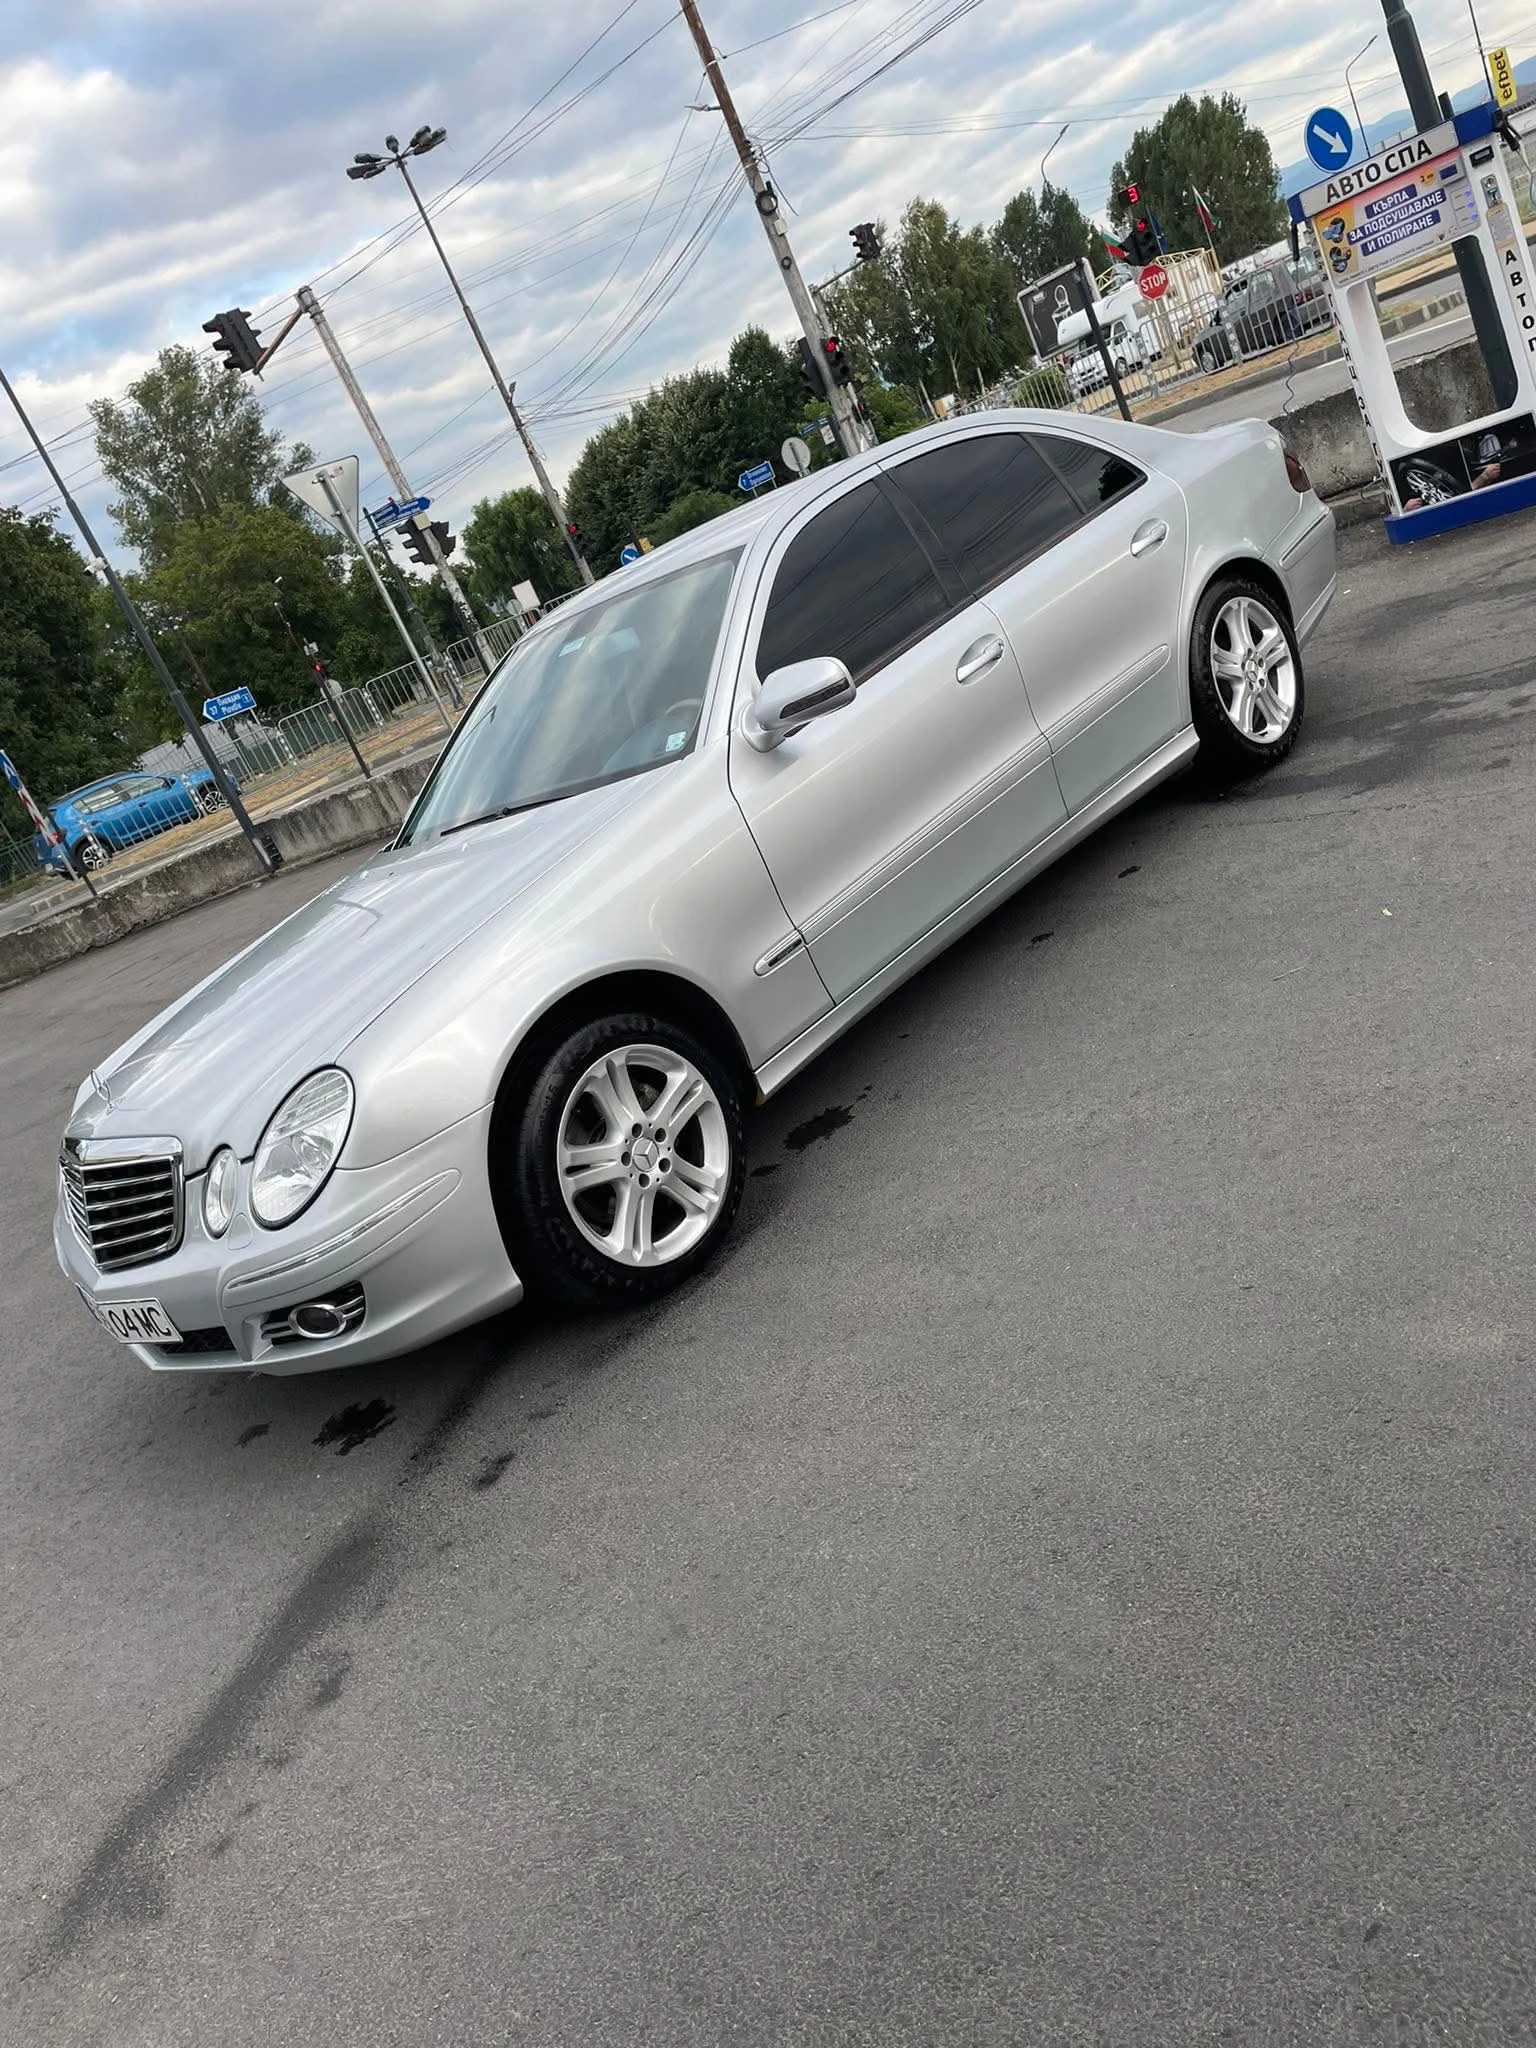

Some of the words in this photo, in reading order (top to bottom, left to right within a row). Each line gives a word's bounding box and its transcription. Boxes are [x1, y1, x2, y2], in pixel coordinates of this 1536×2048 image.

[1493, 51, 1513, 99] efbet
[1326, 163, 1381, 203] АВТО
[1384, 139, 1433, 173] СПА
[1350, 229, 1364, 242] ЗА
[1364, 191, 1443, 235] ПОДСУШАВАНЕ
[1372, 190, 1409, 214] КЪРПА
[1367, 240, 1377, 252] И
[1377, 214, 1435, 248] ПОЛИРАНЕ
[1141, 271, 1166, 292] STOP
